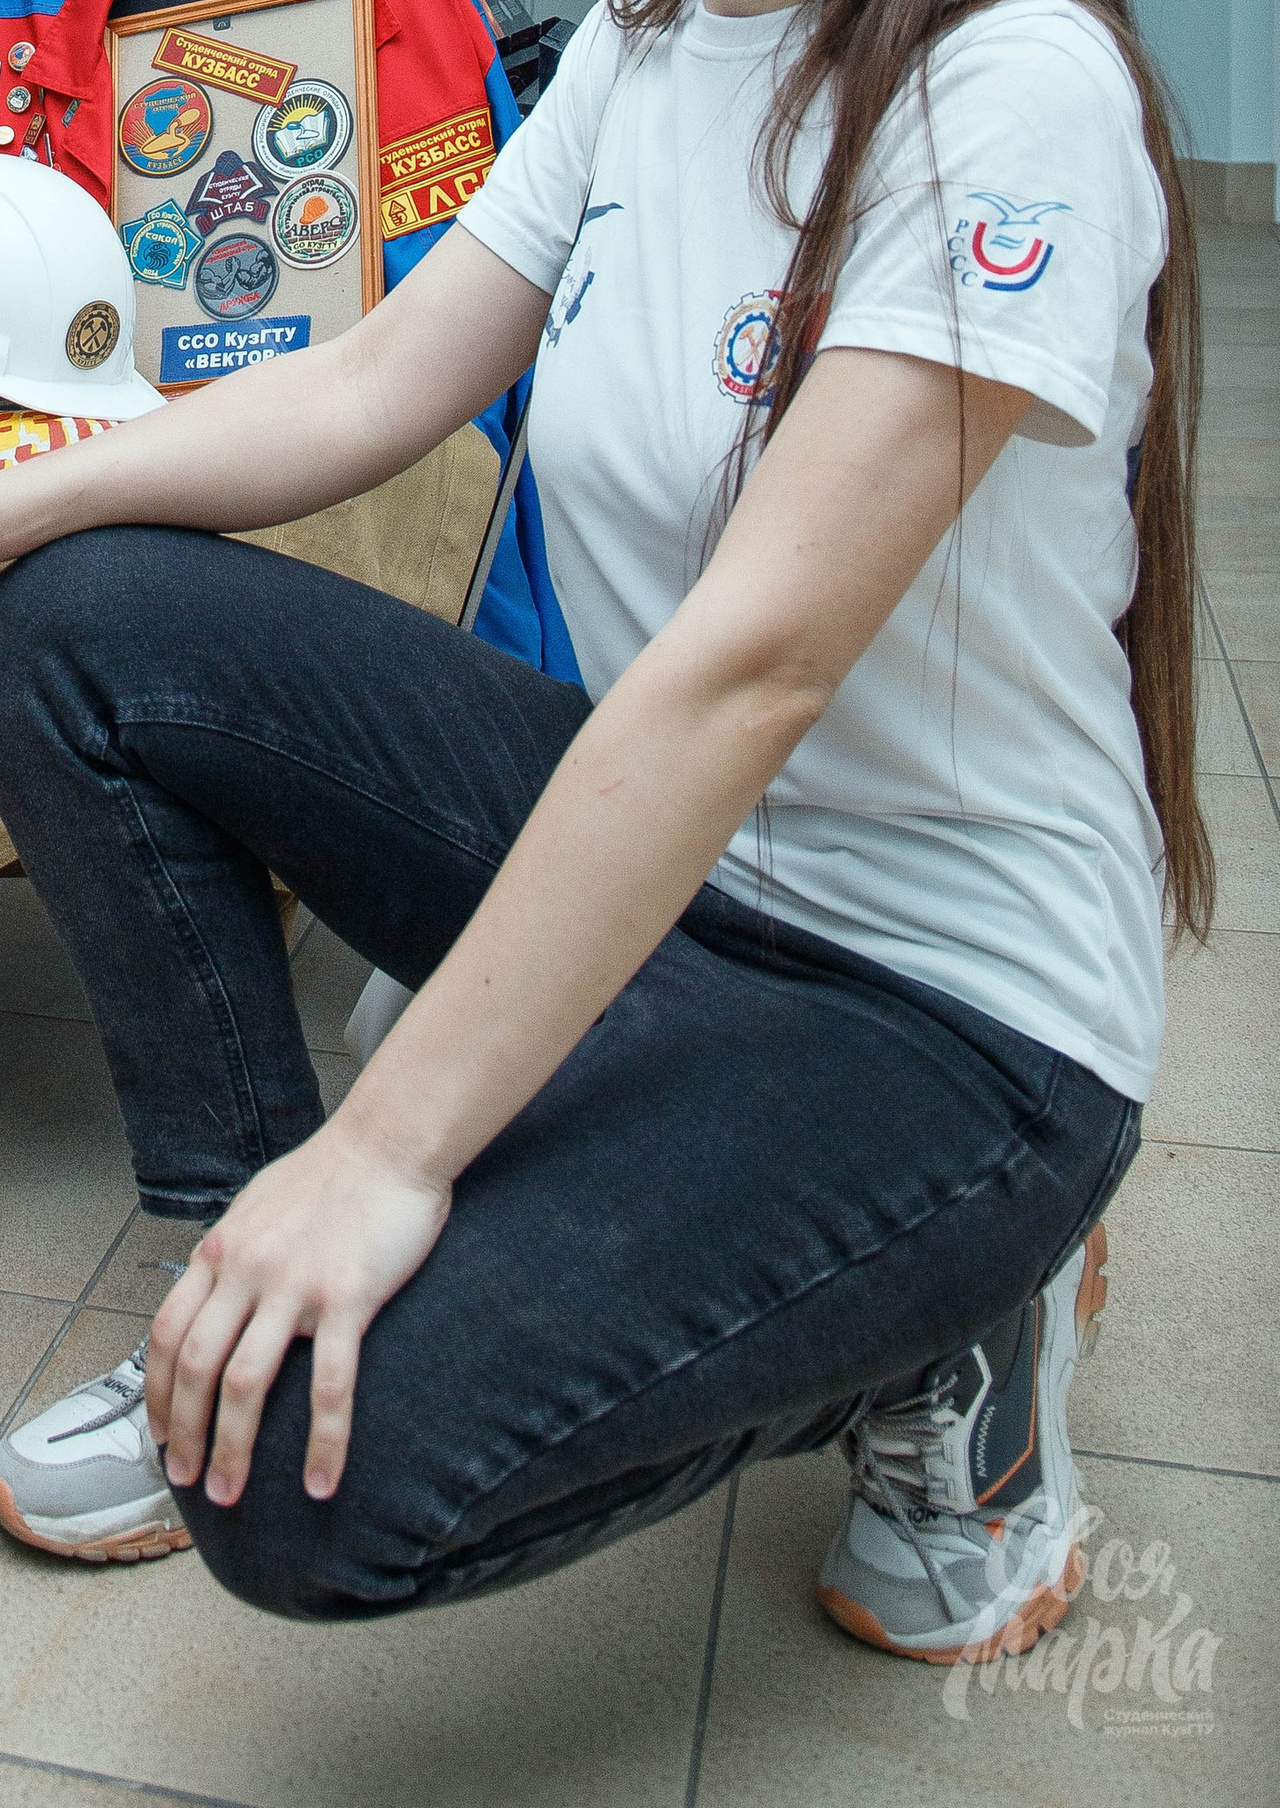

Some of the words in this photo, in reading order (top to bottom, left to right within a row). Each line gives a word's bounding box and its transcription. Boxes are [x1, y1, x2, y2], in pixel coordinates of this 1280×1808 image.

[175, 37, 247, 68] Студенческий
[248, 58, 279, 79] отряд
[180, 51, 261, 90] КУЗБАСС
[258, 106, 275, 144] РОССИЙСКИ
[287, 85, 322, 99] ДЕНЧЕСКИЕ
[296, 149, 324, 167] РСО
[379, 126, 457, 165] туденческий
[457, 117, 487, 134] отряд
[390, 131, 482, 179] КУЗБАСС
[210, 201, 255, 221] ШТАБ
[285, 215, 345, 237] АВЕРС
[177, 333, 220, 351] ССО
[224, 326, 297, 348] КузГТУ
